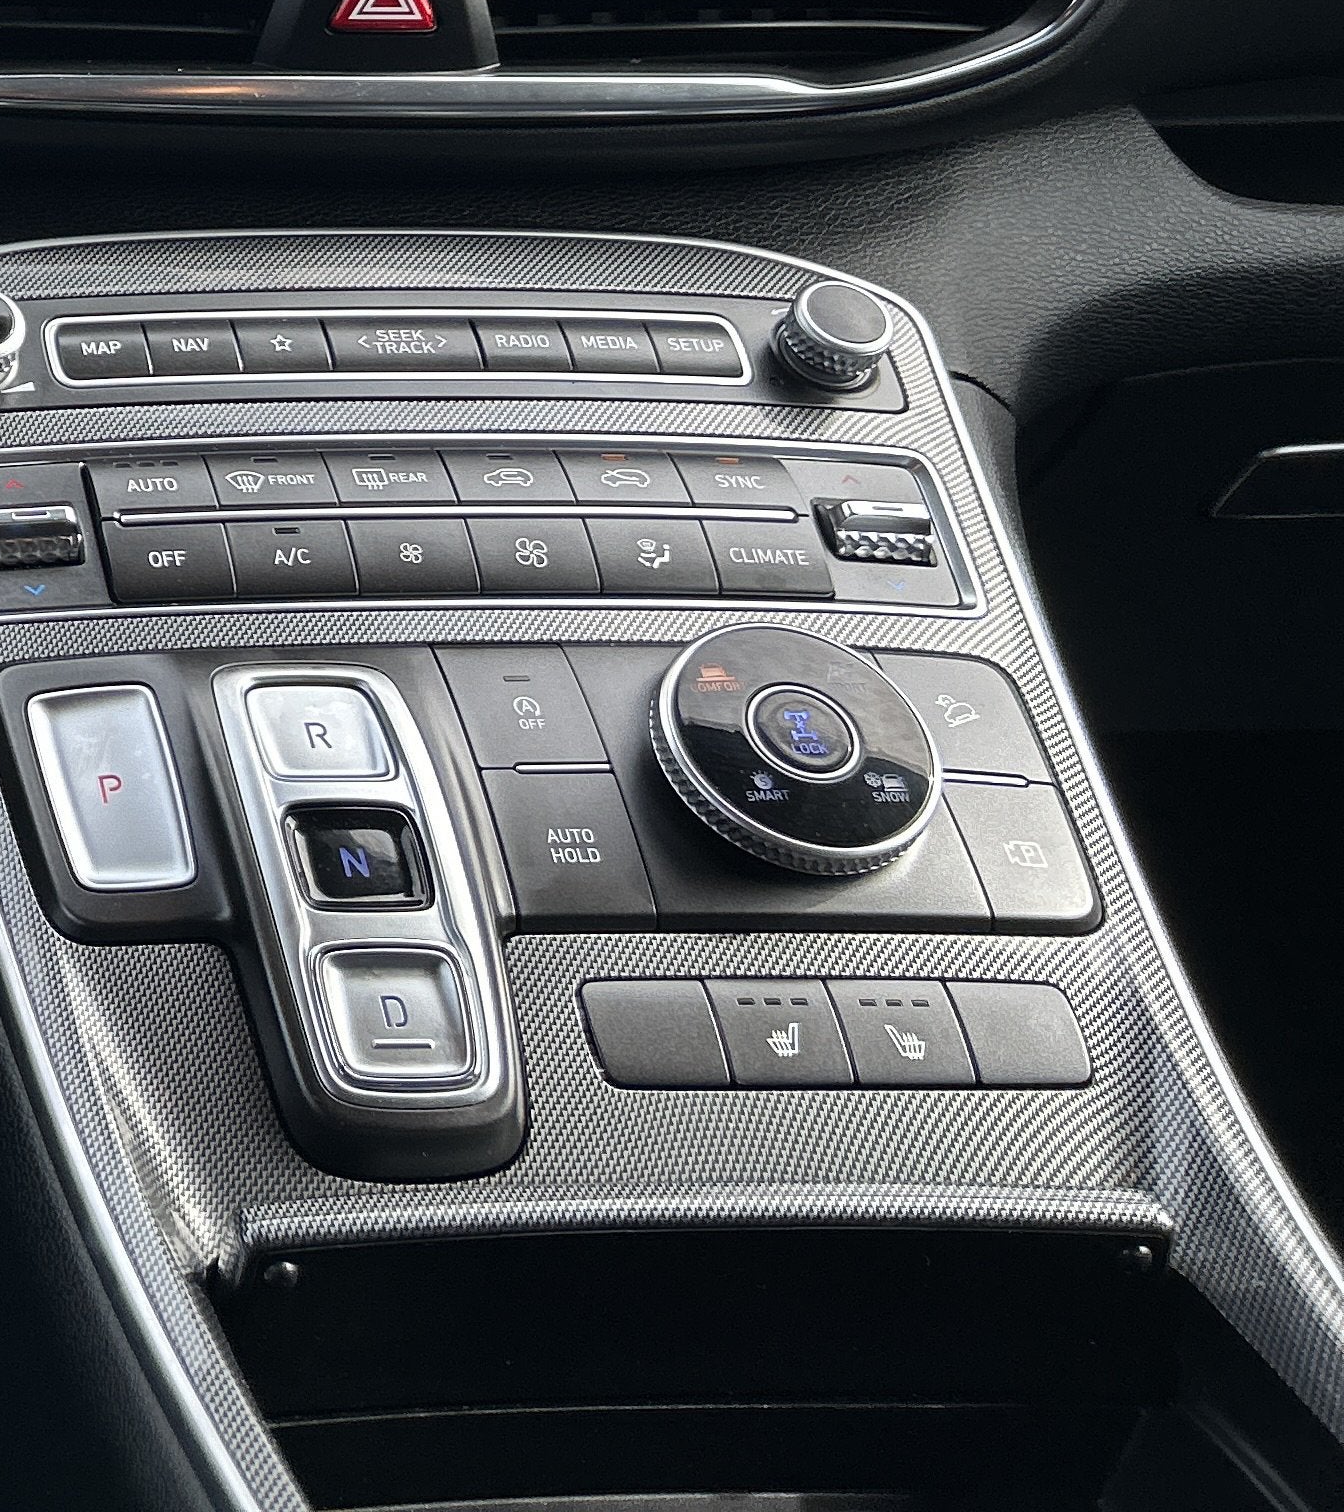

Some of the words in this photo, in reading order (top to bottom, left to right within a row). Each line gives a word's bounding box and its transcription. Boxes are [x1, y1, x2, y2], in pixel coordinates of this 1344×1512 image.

[375, 329, 425, 343] SEEK
[495, 334, 550, 349] RADIO
[581, 335, 638, 350] MEDIA
[81, 340, 121, 357] MAP
[172, 337, 209, 353] NAV
[373, 340, 436, 355] TRACK
[668, 337, 724, 354] SETUP
[126, 476, 178, 493] AUTO
[268, 473, 315, 487] FRONT
[389, 471, 428, 485] REAR
[714, 473, 766, 490] SYNC
[147, 550, 186, 568] OFF
[274, 547, 312, 566] A/C
[729, 547, 810, 566] CLIMATE
[518, 717, 546, 731] OFF
[306, 722, 333, 750] R
[792, 742, 829, 755] LOCK
[97, 773, 123, 804] P
[746, 789, 791, 802] SMART
[872, 792, 910, 803] SNOW
[547, 829, 595, 844] AUTO
[342, 847, 370, 878] N
[550, 847, 600, 864] HOLD
[379, 995, 409, 1029] D
